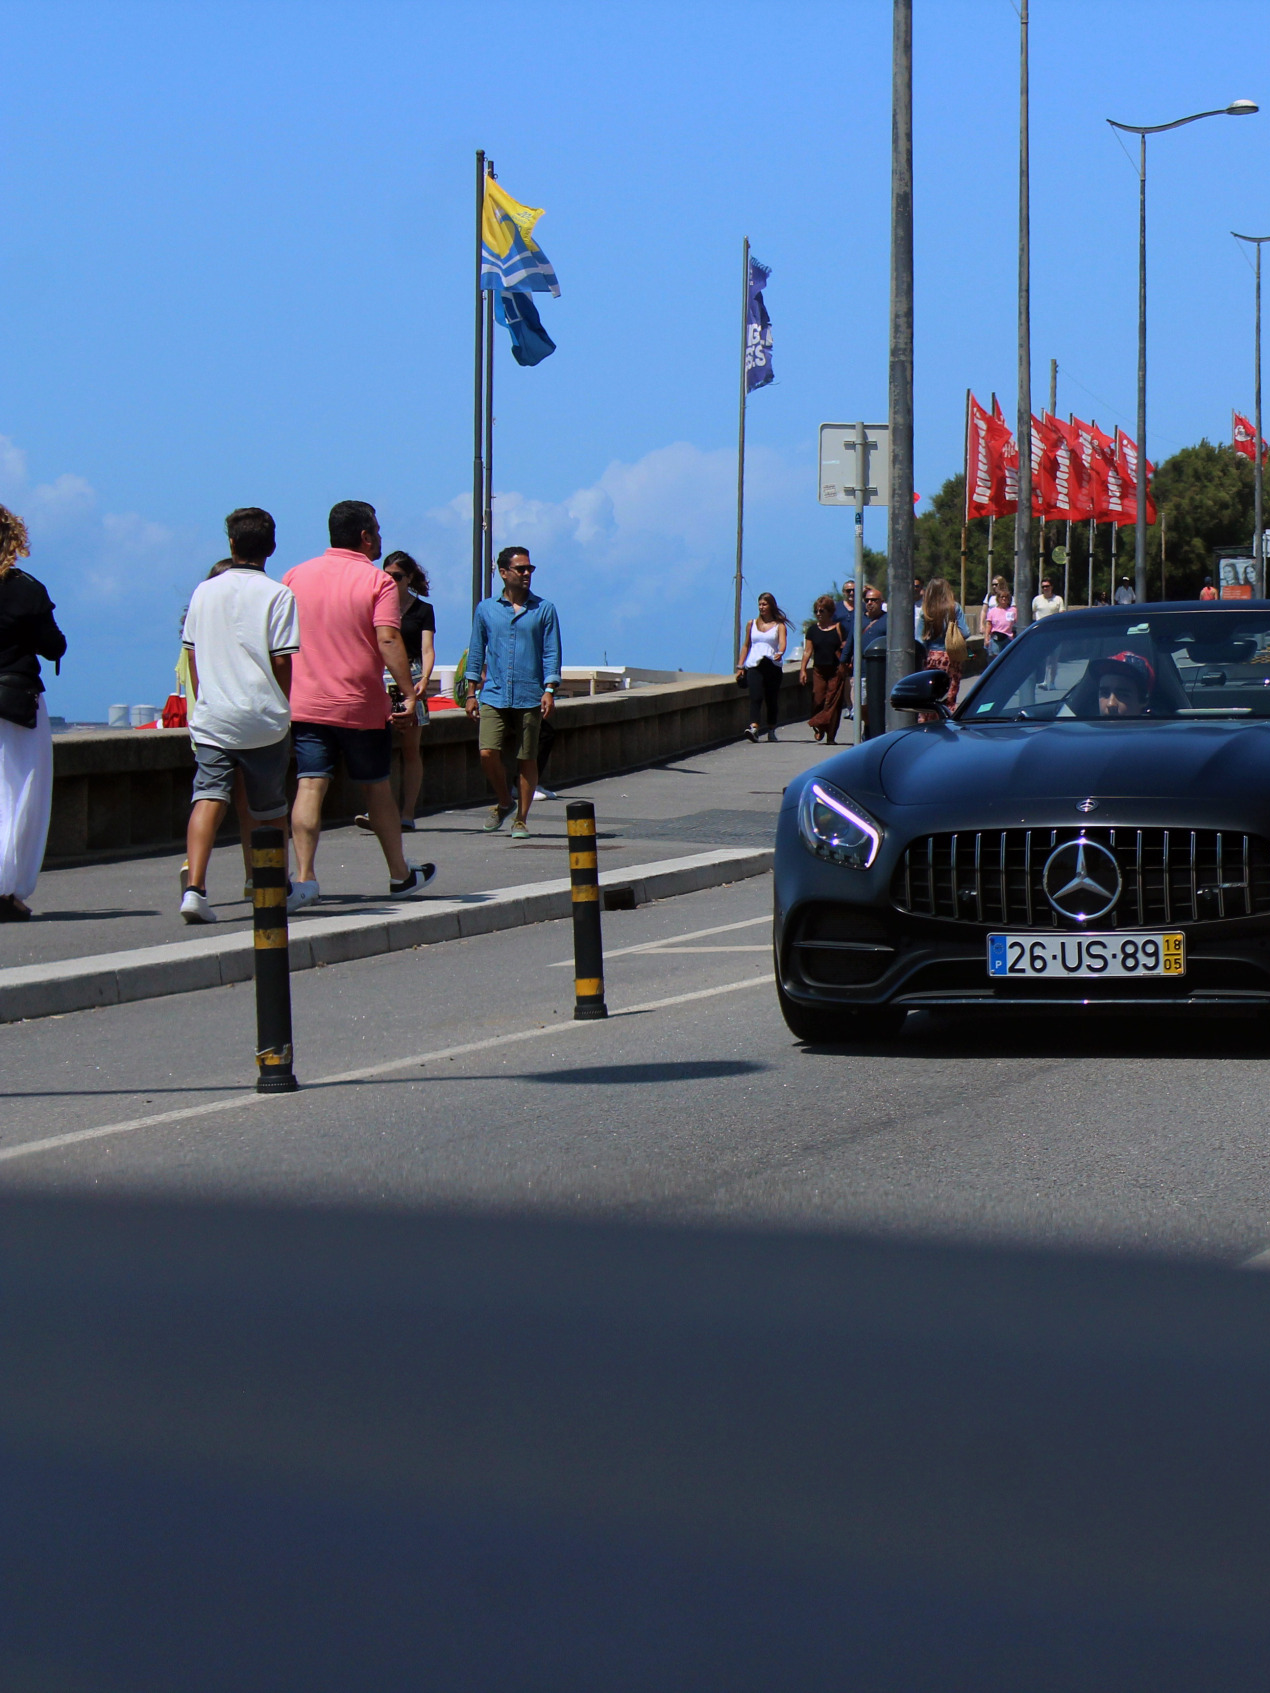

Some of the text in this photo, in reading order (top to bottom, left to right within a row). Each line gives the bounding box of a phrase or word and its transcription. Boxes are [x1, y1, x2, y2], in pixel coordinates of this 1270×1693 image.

[1164, 939, 1181, 951] 18
[995, 960, 1003, 968] P
[1164, 958, 1181, 970] 05
